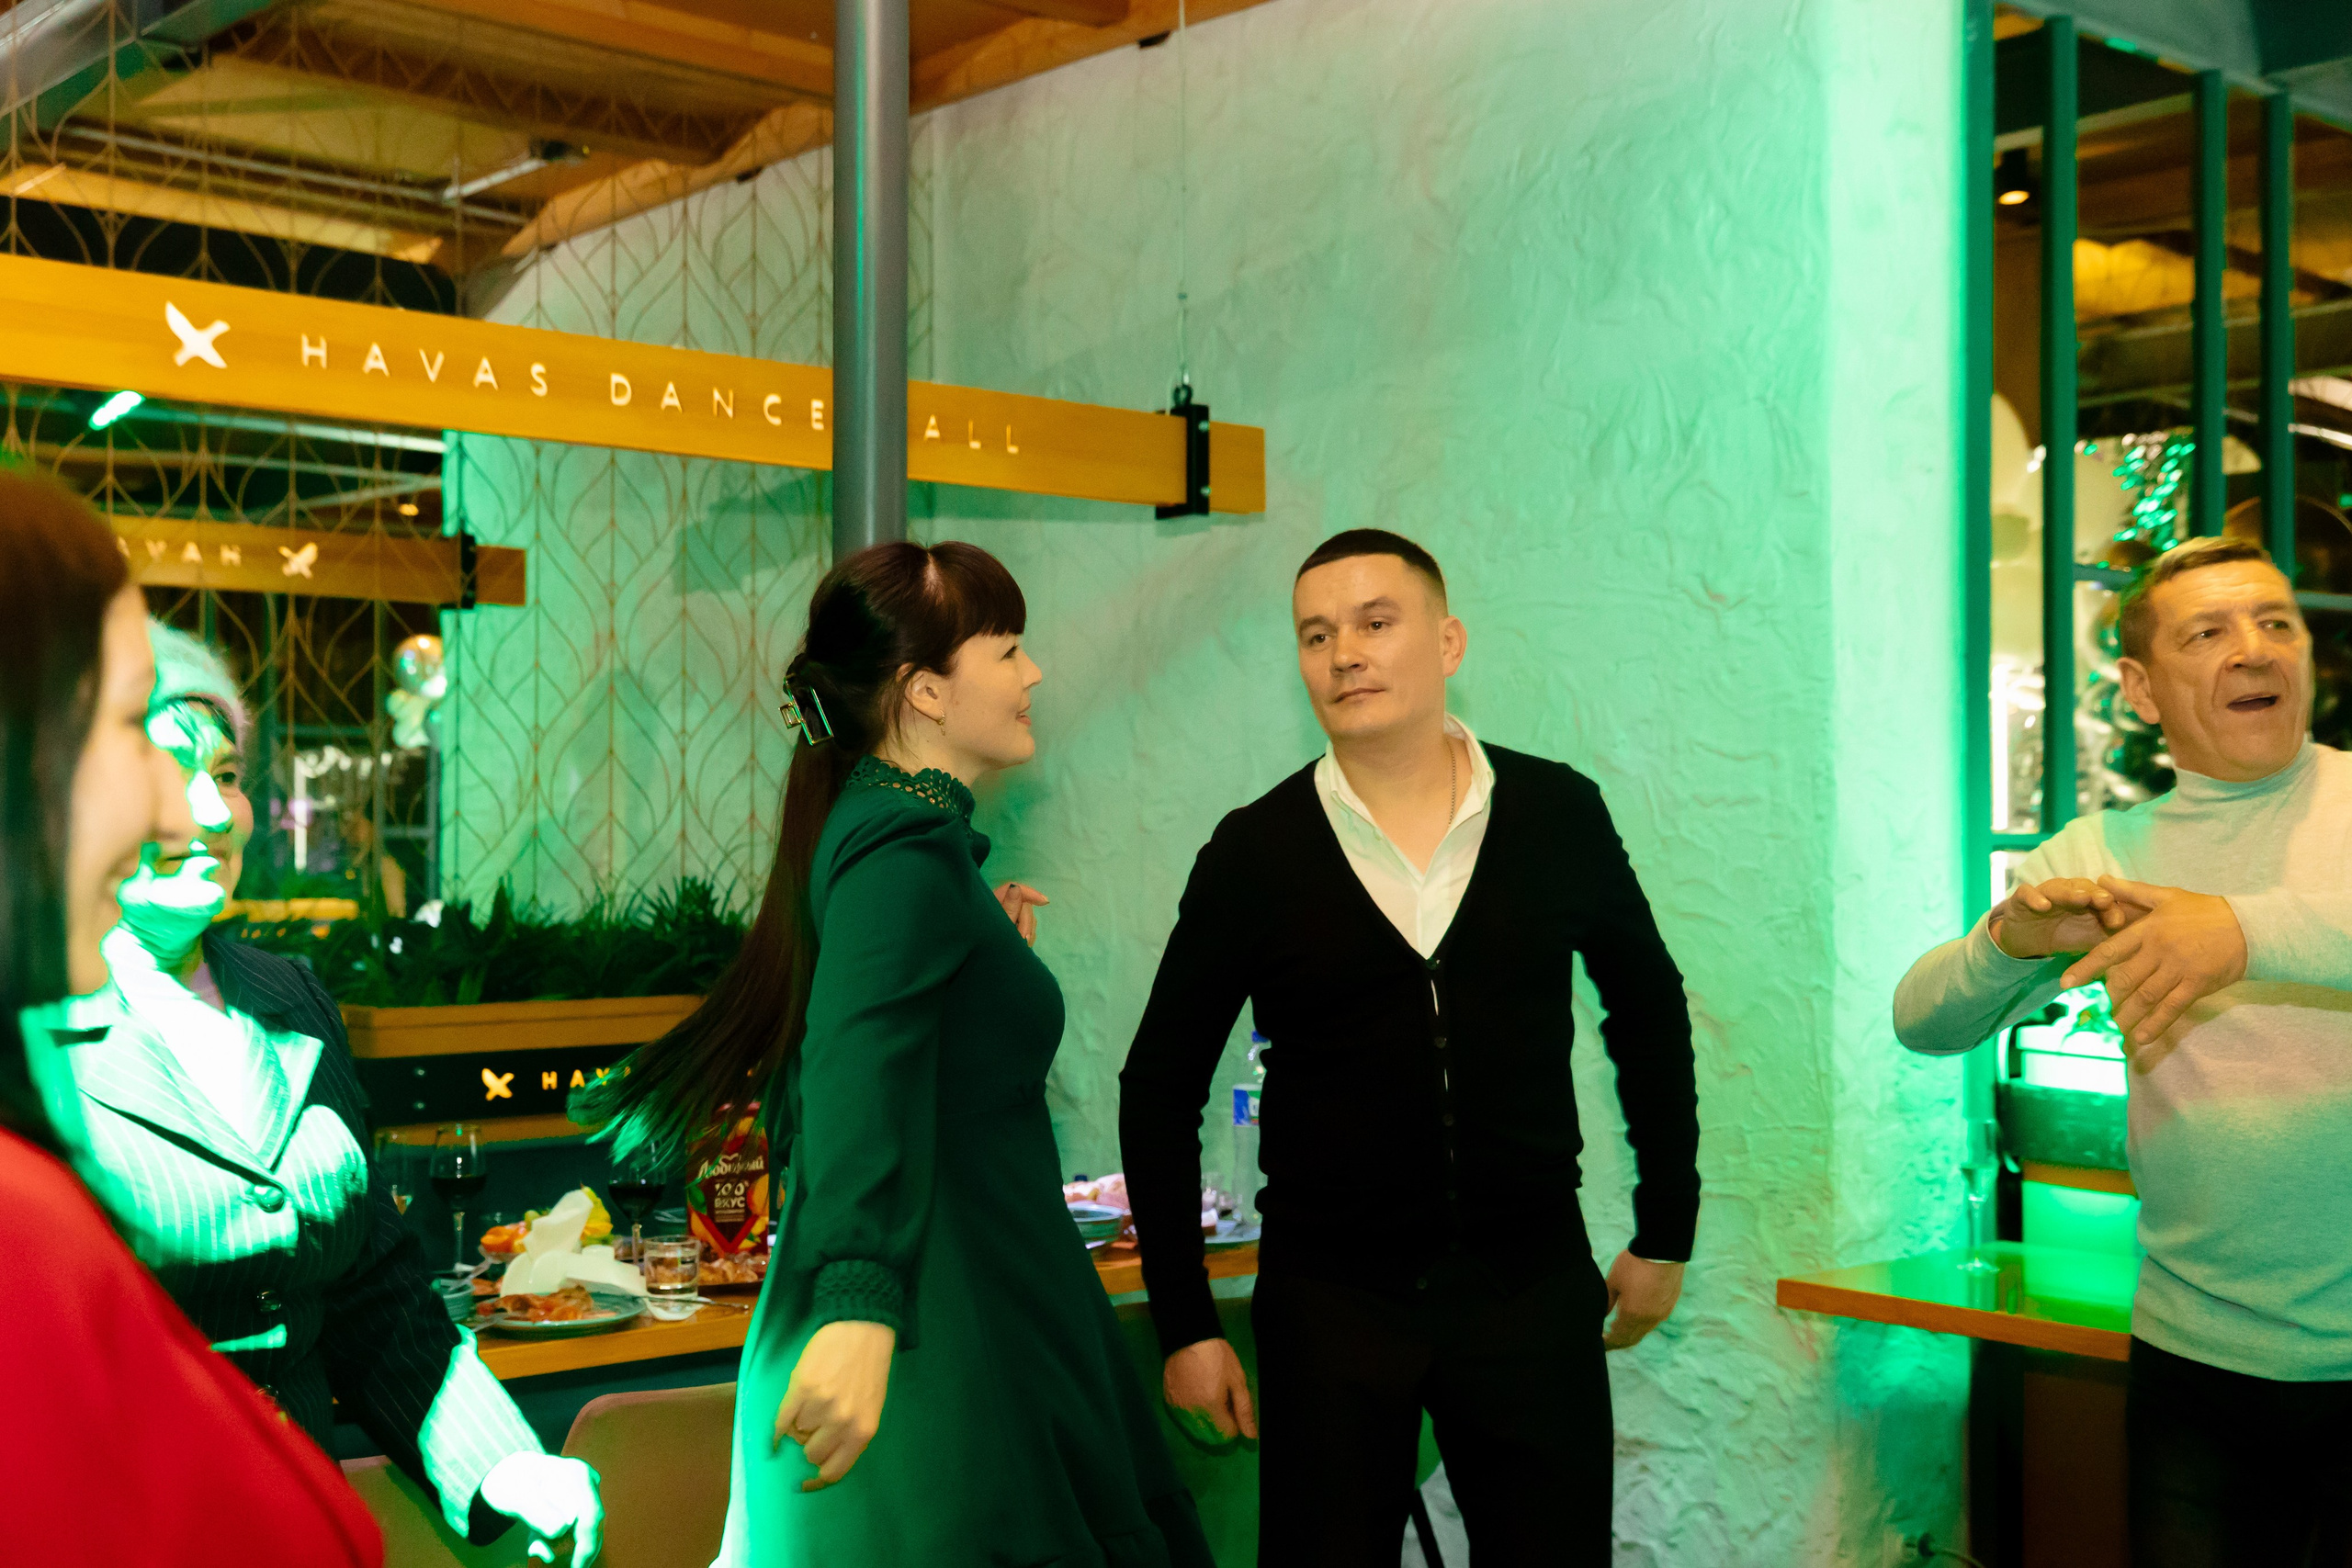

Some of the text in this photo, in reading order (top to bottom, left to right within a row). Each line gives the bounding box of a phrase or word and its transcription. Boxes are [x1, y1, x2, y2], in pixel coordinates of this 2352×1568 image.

[300, 333, 1019, 454] HAVAS DANCE ALL
[542, 1066, 631, 1090] HAV
